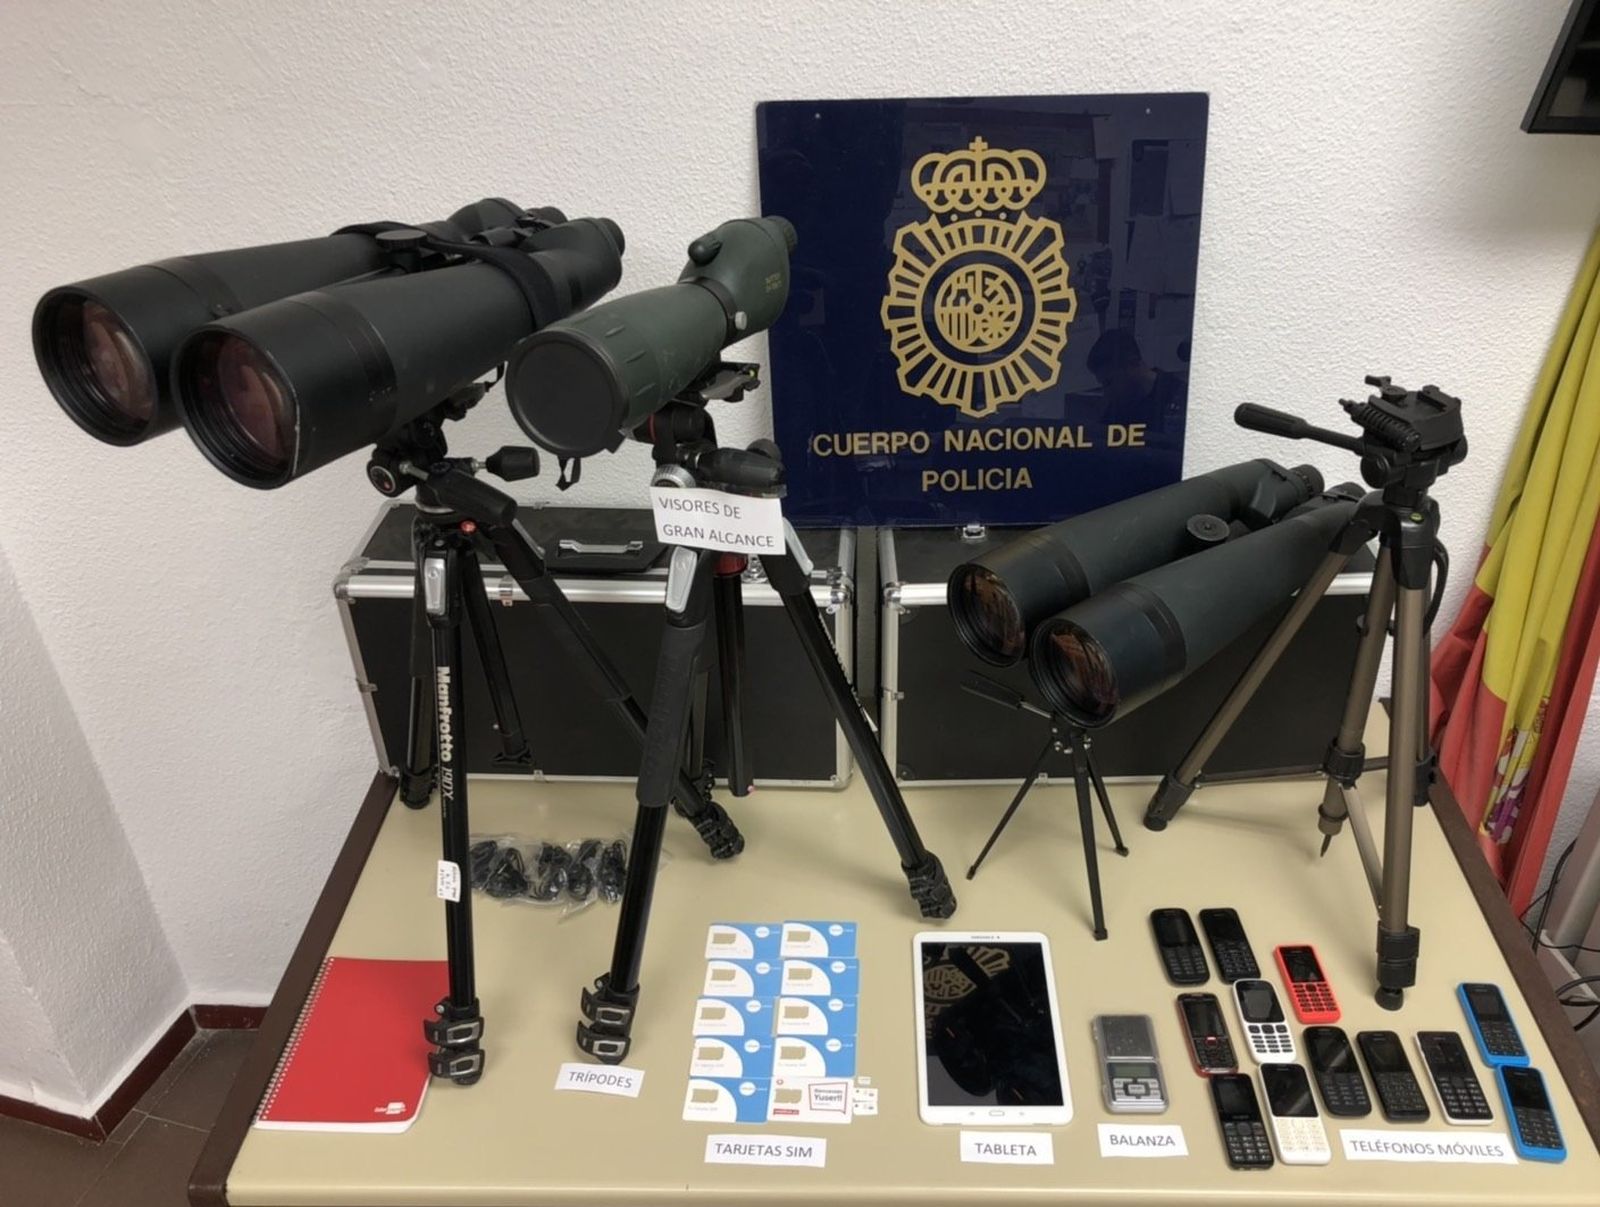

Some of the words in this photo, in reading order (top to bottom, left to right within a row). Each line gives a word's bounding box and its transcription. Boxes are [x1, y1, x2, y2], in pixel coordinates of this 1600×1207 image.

[812, 431, 930, 456] CUERPO
[944, 424, 1093, 452] NACIONAL
[1107, 423, 1147, 448] DE
[921, 467, 1033, 492] POLICIA
[658, 497, 720, 515] VISORES
[723, 504, 742, 519] DE
[662, 523, 704, 539] GRAN
[708, 529, 775, 547] ALCANCE
[437, 666, 452, 763] Manfrotto
[568, 1070, 633, 1090] TRÍPODES
[715, 1142, 782, 1157] TARJETAS
[786, 1144, 813, 1159] SIM
[974, 1143, 1037, 1156] TABLETA
[1109, 1134, 1176, 1147] BALANZA
[1350, 1138, 1433, 1156] TELÉFONOS
[1437, 1141, 1504, 1157] MÓVILES
